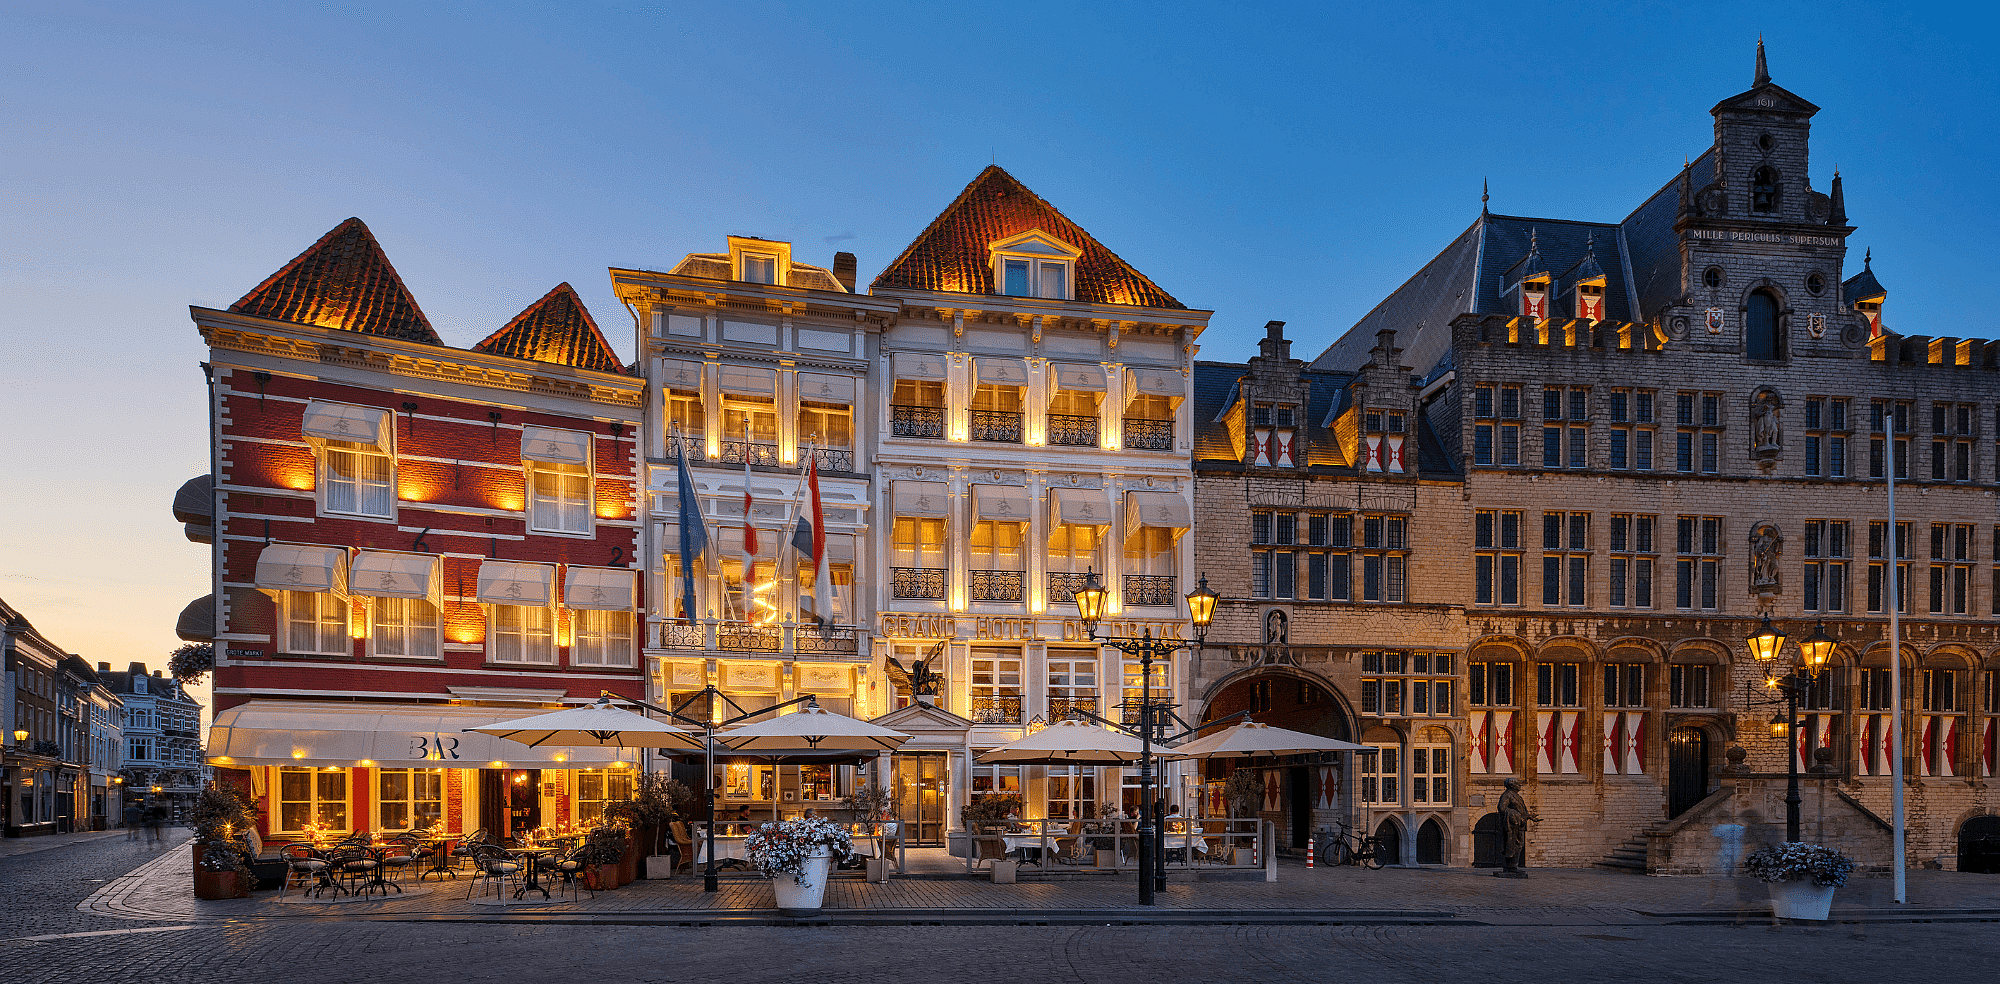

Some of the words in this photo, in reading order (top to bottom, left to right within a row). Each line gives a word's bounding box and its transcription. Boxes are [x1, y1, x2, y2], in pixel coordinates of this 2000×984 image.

[1693, 229, 1724, 240] MILLE
[1731, 231, 1781, 243] PERICULIS
[1789, 235, 1839, 247] SUPERSUM
[881, 614, 957, 639] GRAND
[976, 617, 1046, 641] HOTEL
[1064, 619, 1091, 642] DE
[1111, 620, 1186, 643] DRAAK
[409, 736, 460, 760] BAR
